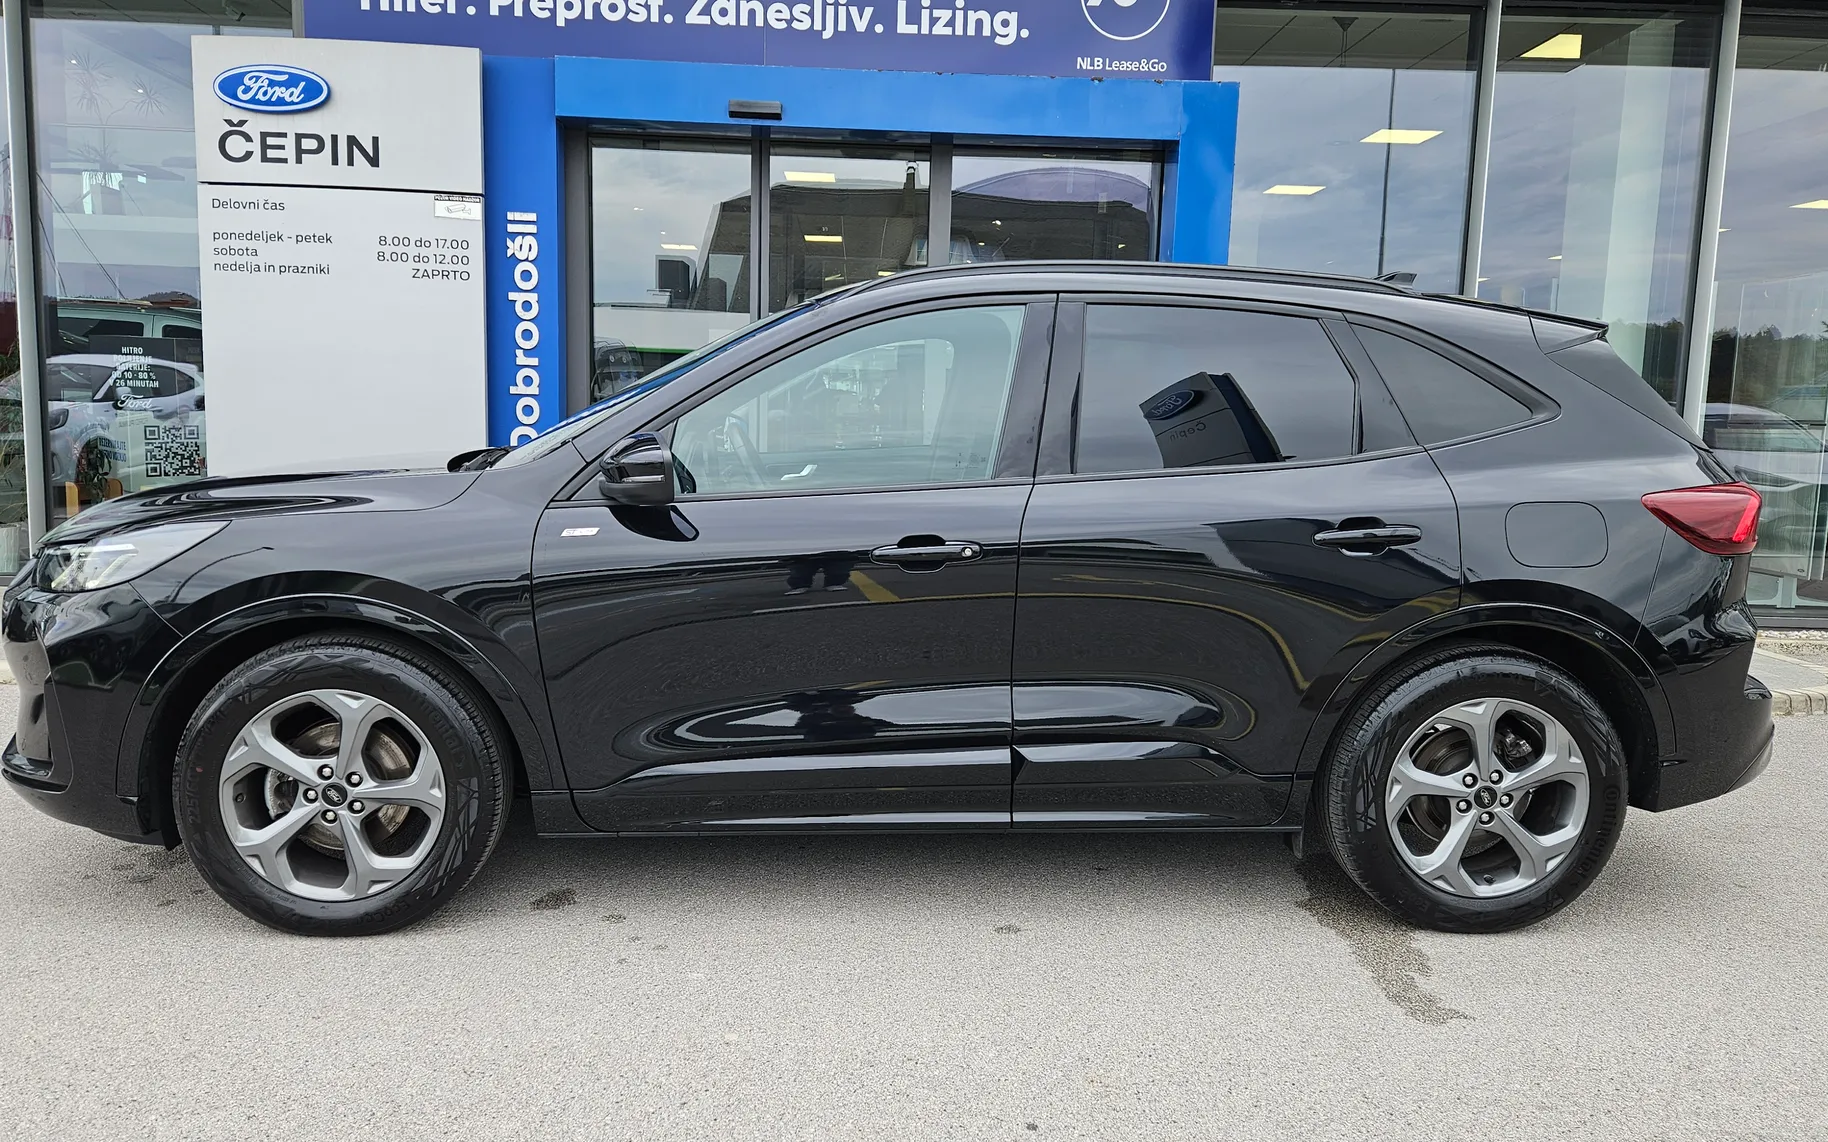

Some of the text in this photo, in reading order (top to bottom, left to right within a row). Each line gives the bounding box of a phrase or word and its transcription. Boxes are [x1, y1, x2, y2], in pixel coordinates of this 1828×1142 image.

[685, 0, 884, 40] Zanesljiv.
[896, 0, 1030, 46] Lizing.
[1076, 57, 1168, 72] NLB Lease&Go
[237, 71, 306, 103] Ford
[218, 119, 380, 168] ČEPIN
[212, 198, 285, 211] Delovni čas
[212, 230, 284, 244] ponedeljek
[295, 233, 333, 245] petek
[378, 235, 470, 250] 8.00 do 17.00
[213, 245, 259, 257] sobota
[377, 251, 470, 266] 8.00 do 12.00
[213, 261, 330, 275] nedelja in prazniki
[412, 268, 471, 281] ZAPRTO
[121, 346, 143, 354] HITRO
[123, 371, 133, 379] 10
[138, 371, 148, 379] 80
[149, 372, 156, 380] %
[115, 379, 125, 387] 26
[126, 380, 159, 388] MINUTAH
[117, 393, 152, 409] Ford
